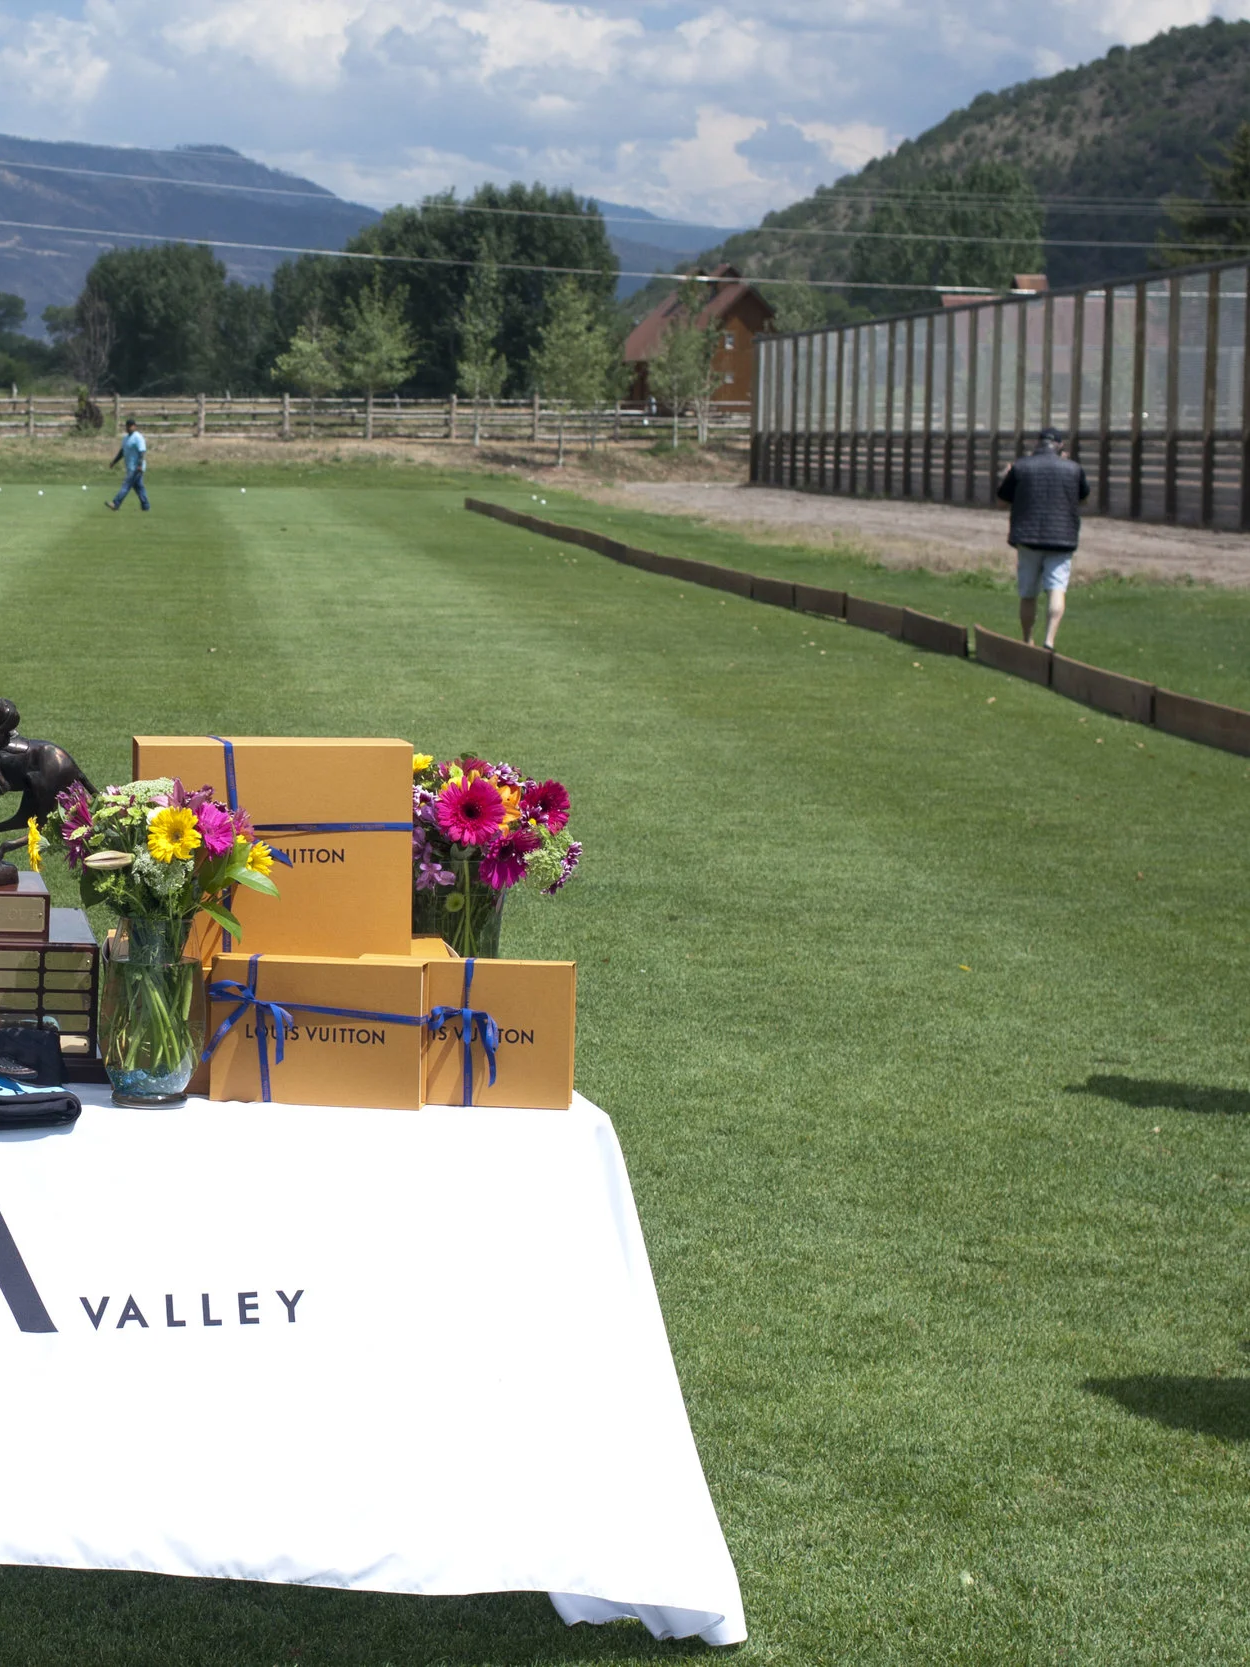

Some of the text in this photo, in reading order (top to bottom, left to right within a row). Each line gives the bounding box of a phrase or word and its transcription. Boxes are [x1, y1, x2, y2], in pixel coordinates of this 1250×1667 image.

[7, 908, 41, 921] CUP
[305, 1026, 386, 1045] VUITTON
[80, 1290, 304, 1330] VALLEY
